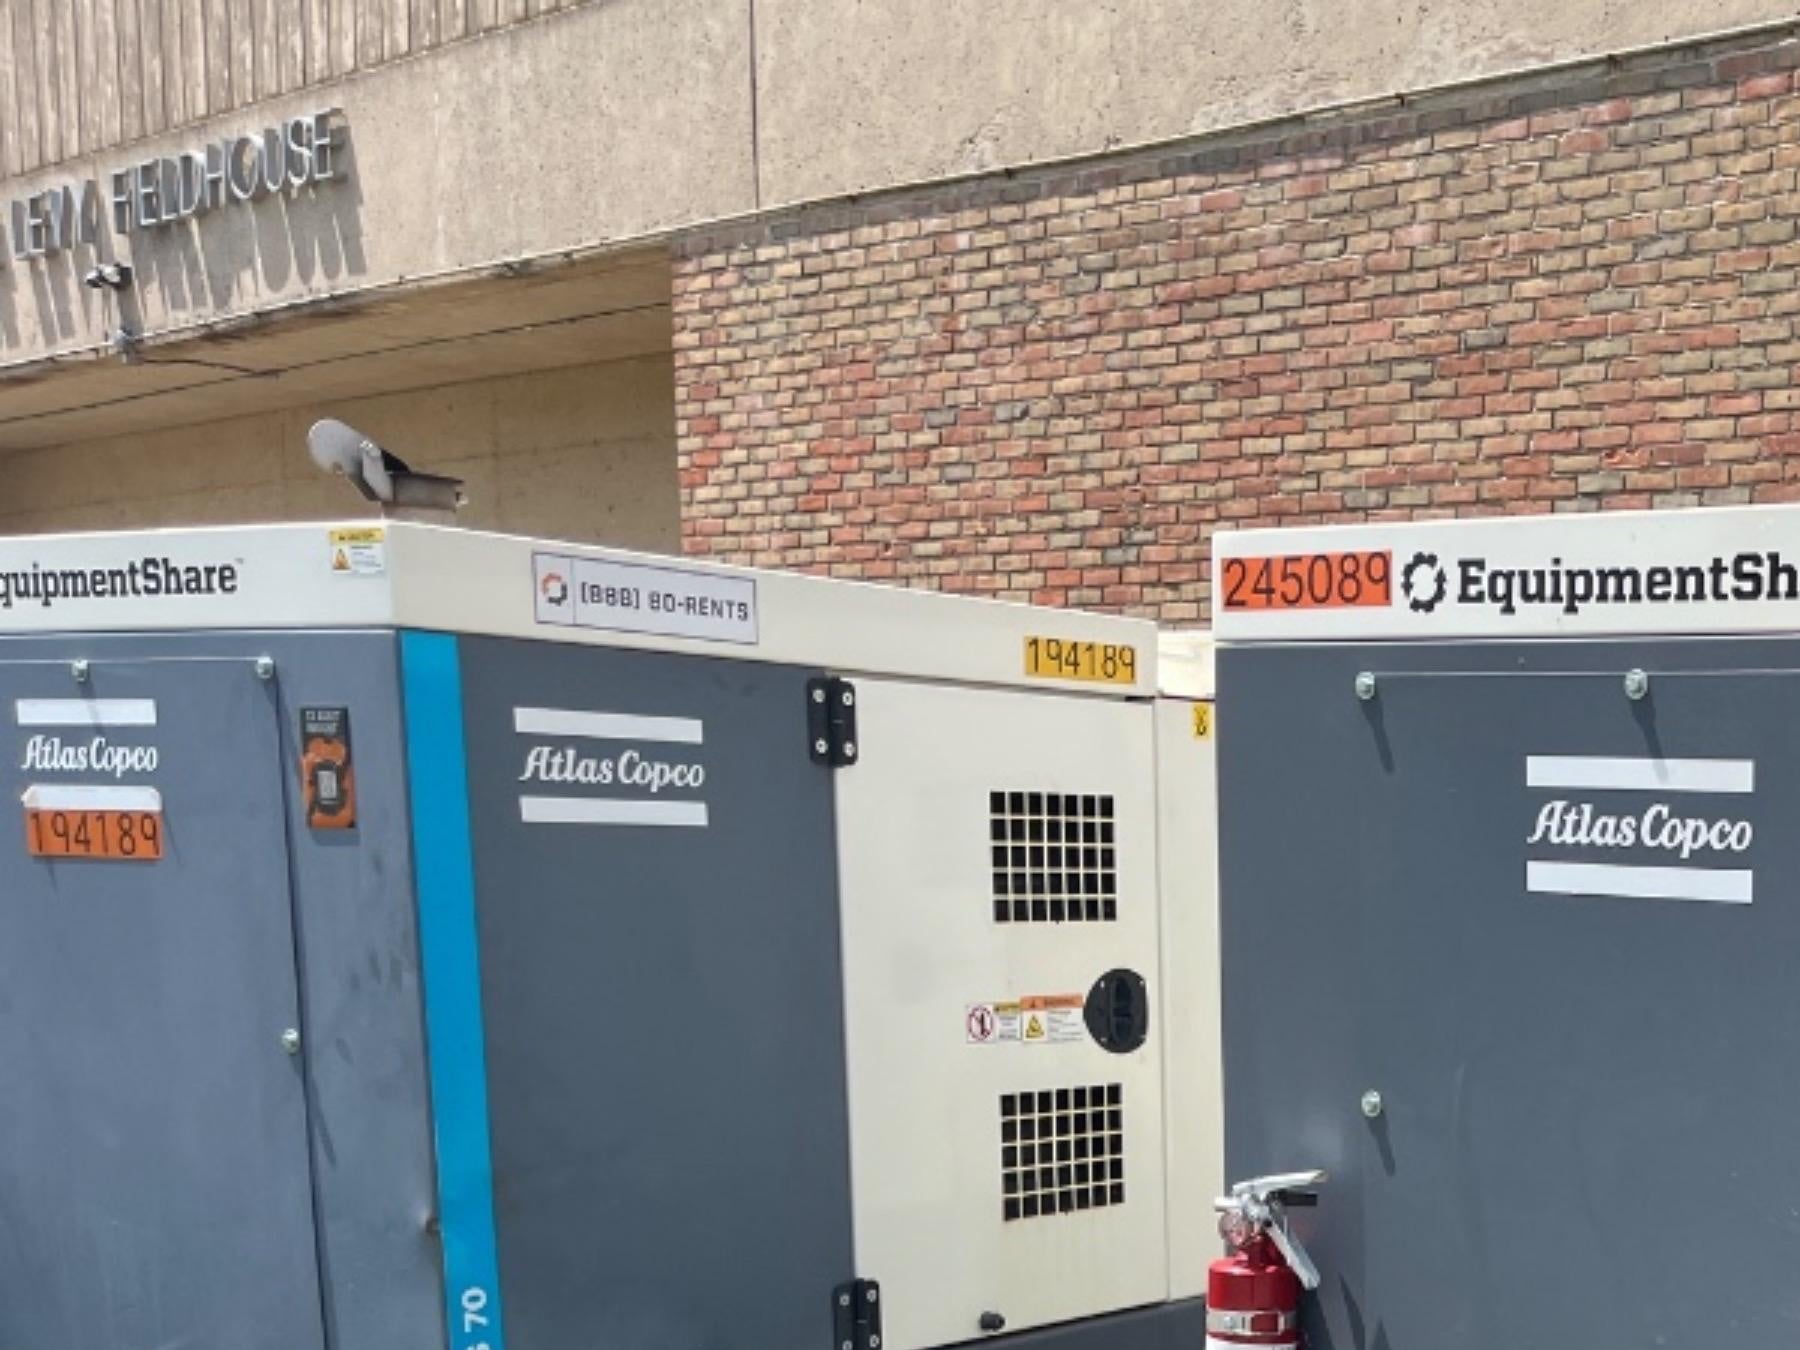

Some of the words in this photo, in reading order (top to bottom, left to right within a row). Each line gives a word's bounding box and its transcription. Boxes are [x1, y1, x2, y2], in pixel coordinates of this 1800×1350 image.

[112, 108, 344, 234] FIELDHOUSE
[1224, 551, 1391, 607] 245089
[1027, 637, 1137, 681] 194189
[21, 735, 88, 770] Atlas
[89, 736, 158, 778] Copco
[518, 746, 614, 784] Atlas
[617, 749, 705, 793] Copco
[30, 811, 161, 857] 194189
[1527, 800, 1637, 846] Atlas
[1640, 803, 1753, 859] Copco
[461, 1286, 489, 1333] 70
